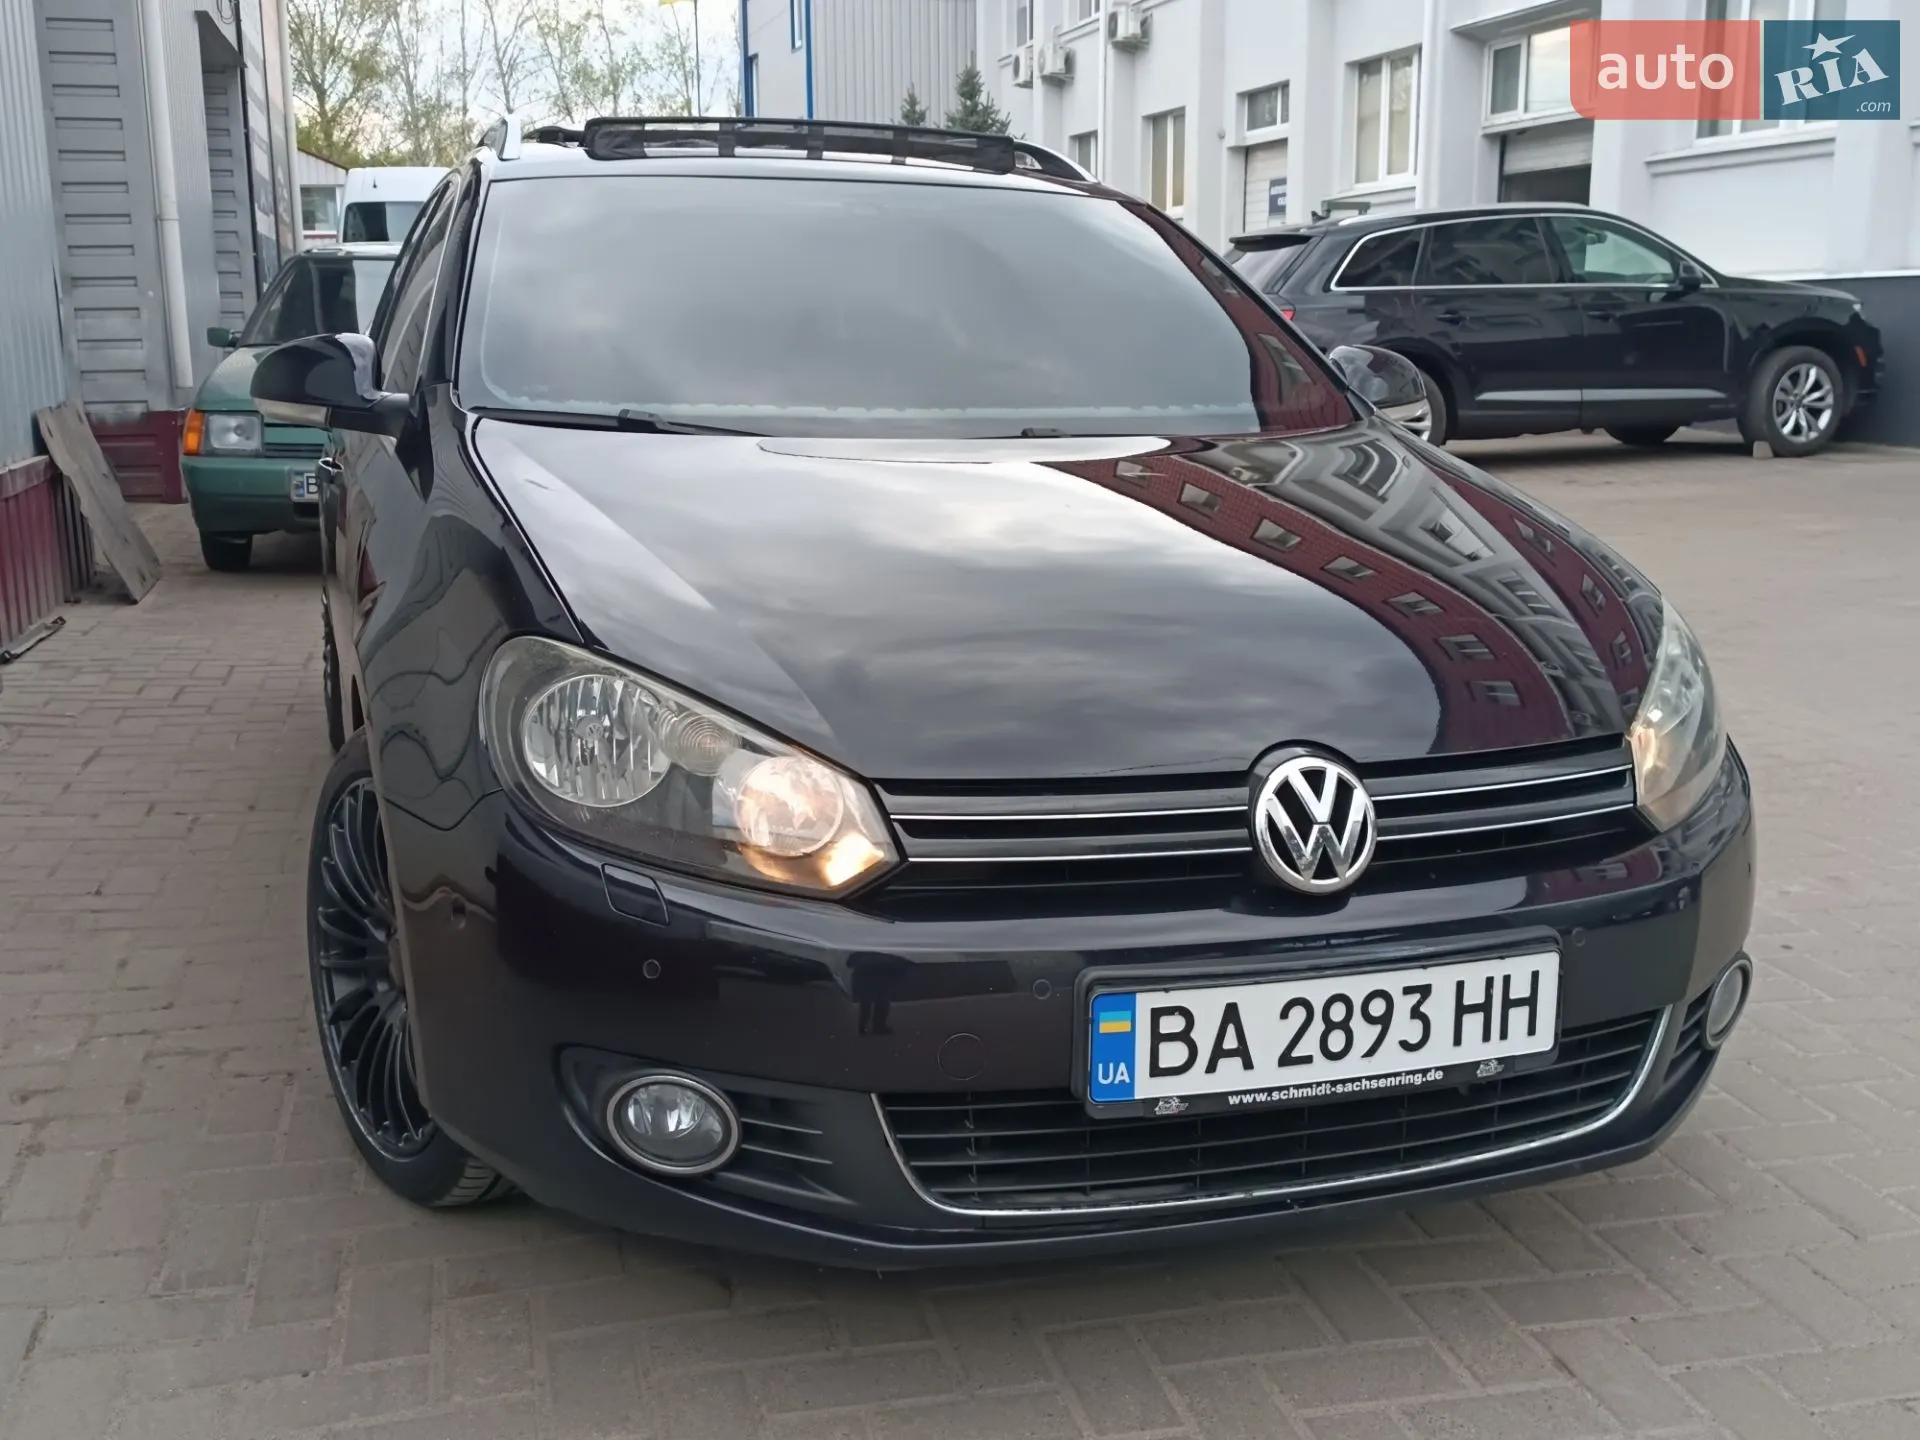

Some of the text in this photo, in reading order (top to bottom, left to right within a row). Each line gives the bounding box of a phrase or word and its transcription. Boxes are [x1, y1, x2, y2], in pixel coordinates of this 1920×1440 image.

[1149, 970, 1539, 1078] BA 2893 HH
[1098, 1062, 1130, 1084] UA
[1228, 1068, 1444, 1105] www.schmidt-sachsenring.de
